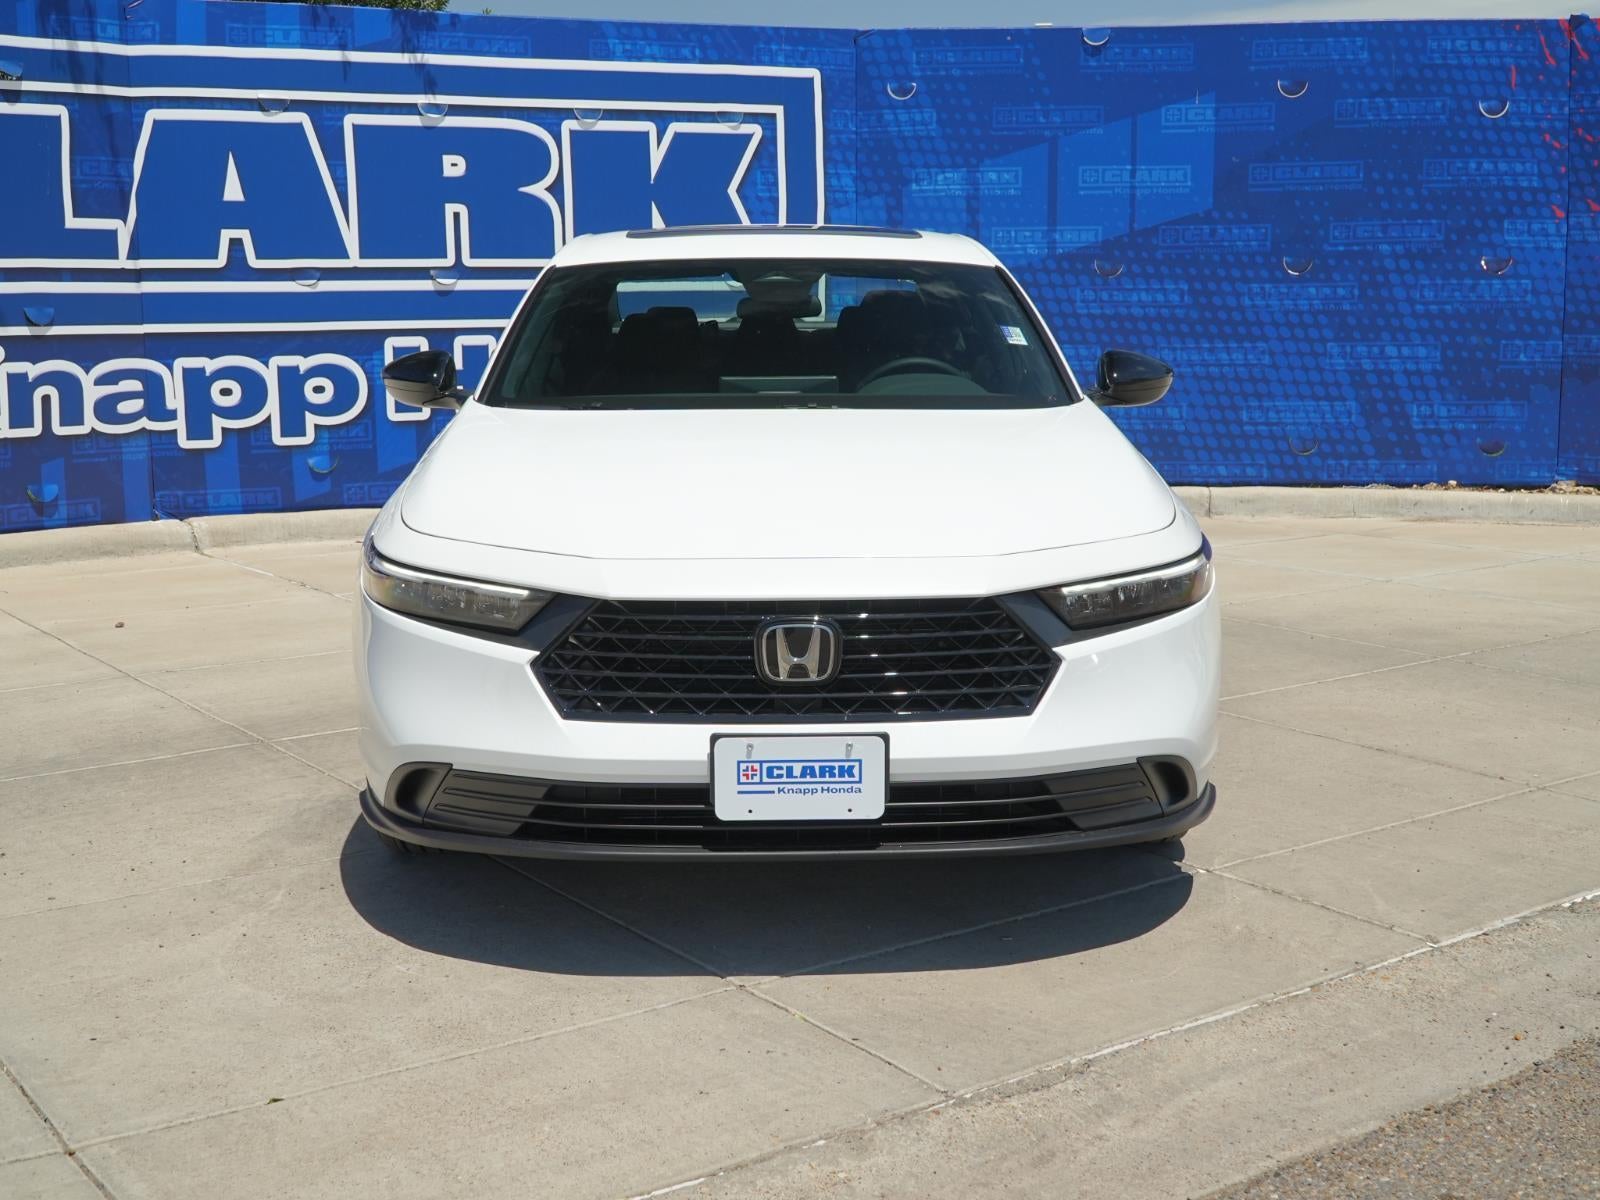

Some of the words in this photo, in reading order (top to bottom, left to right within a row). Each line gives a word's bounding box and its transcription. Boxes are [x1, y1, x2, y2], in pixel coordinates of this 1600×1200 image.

[1105, 170, 1185, 181] CLARK
[0, 345, 368, 448] napp
[766, 765, 856, 780] CLARK
[778, 787, 819, 796] Knapp
[821, 786, 862, 794] Honda
